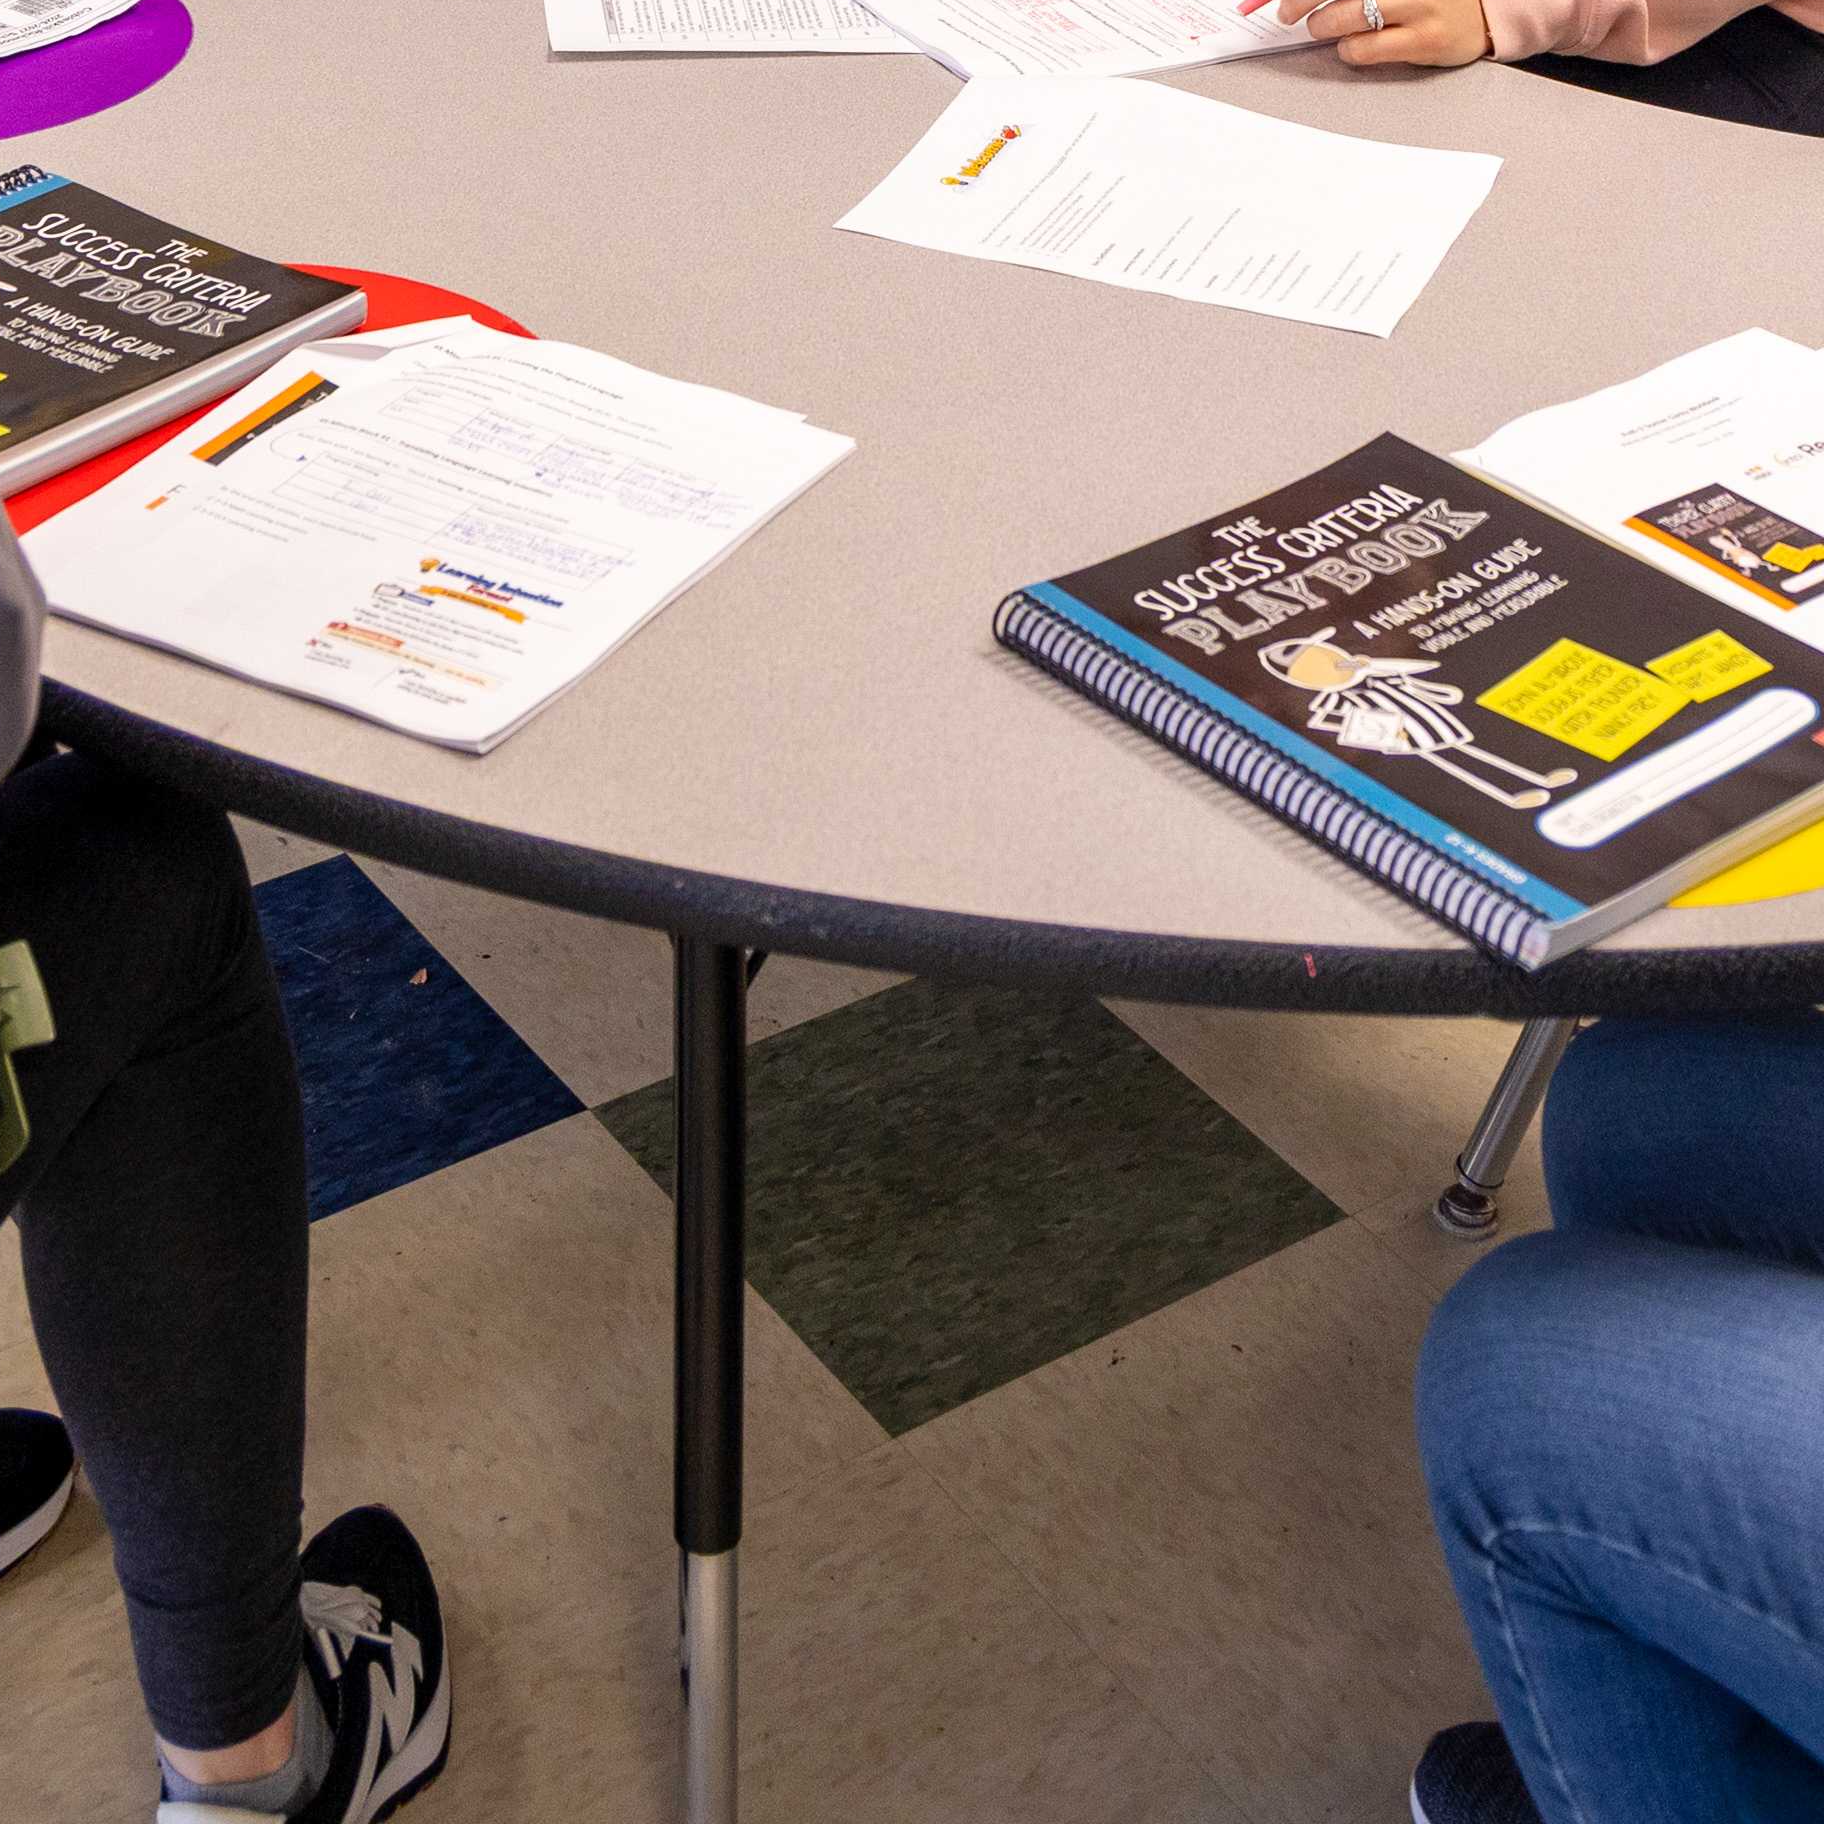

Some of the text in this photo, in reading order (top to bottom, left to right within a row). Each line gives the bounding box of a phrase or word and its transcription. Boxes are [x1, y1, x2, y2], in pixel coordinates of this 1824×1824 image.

[21, 212, 272, 315] SUCCESS CRITERIA
[155, 239, 208, 264] THE
[3, 296, 175, 361] A HANDS-ON GUIDE
[1133, 482, 1424, 623] SUCCESS CRITERIA
[1211, 515, 1277, 549] THE
[436, 562, 496, 589] Learning
[1161, 496, 1491, 657] PLAYBOOK
[1351, 537, 1543, 640] A HANDS-ON GUIDE
